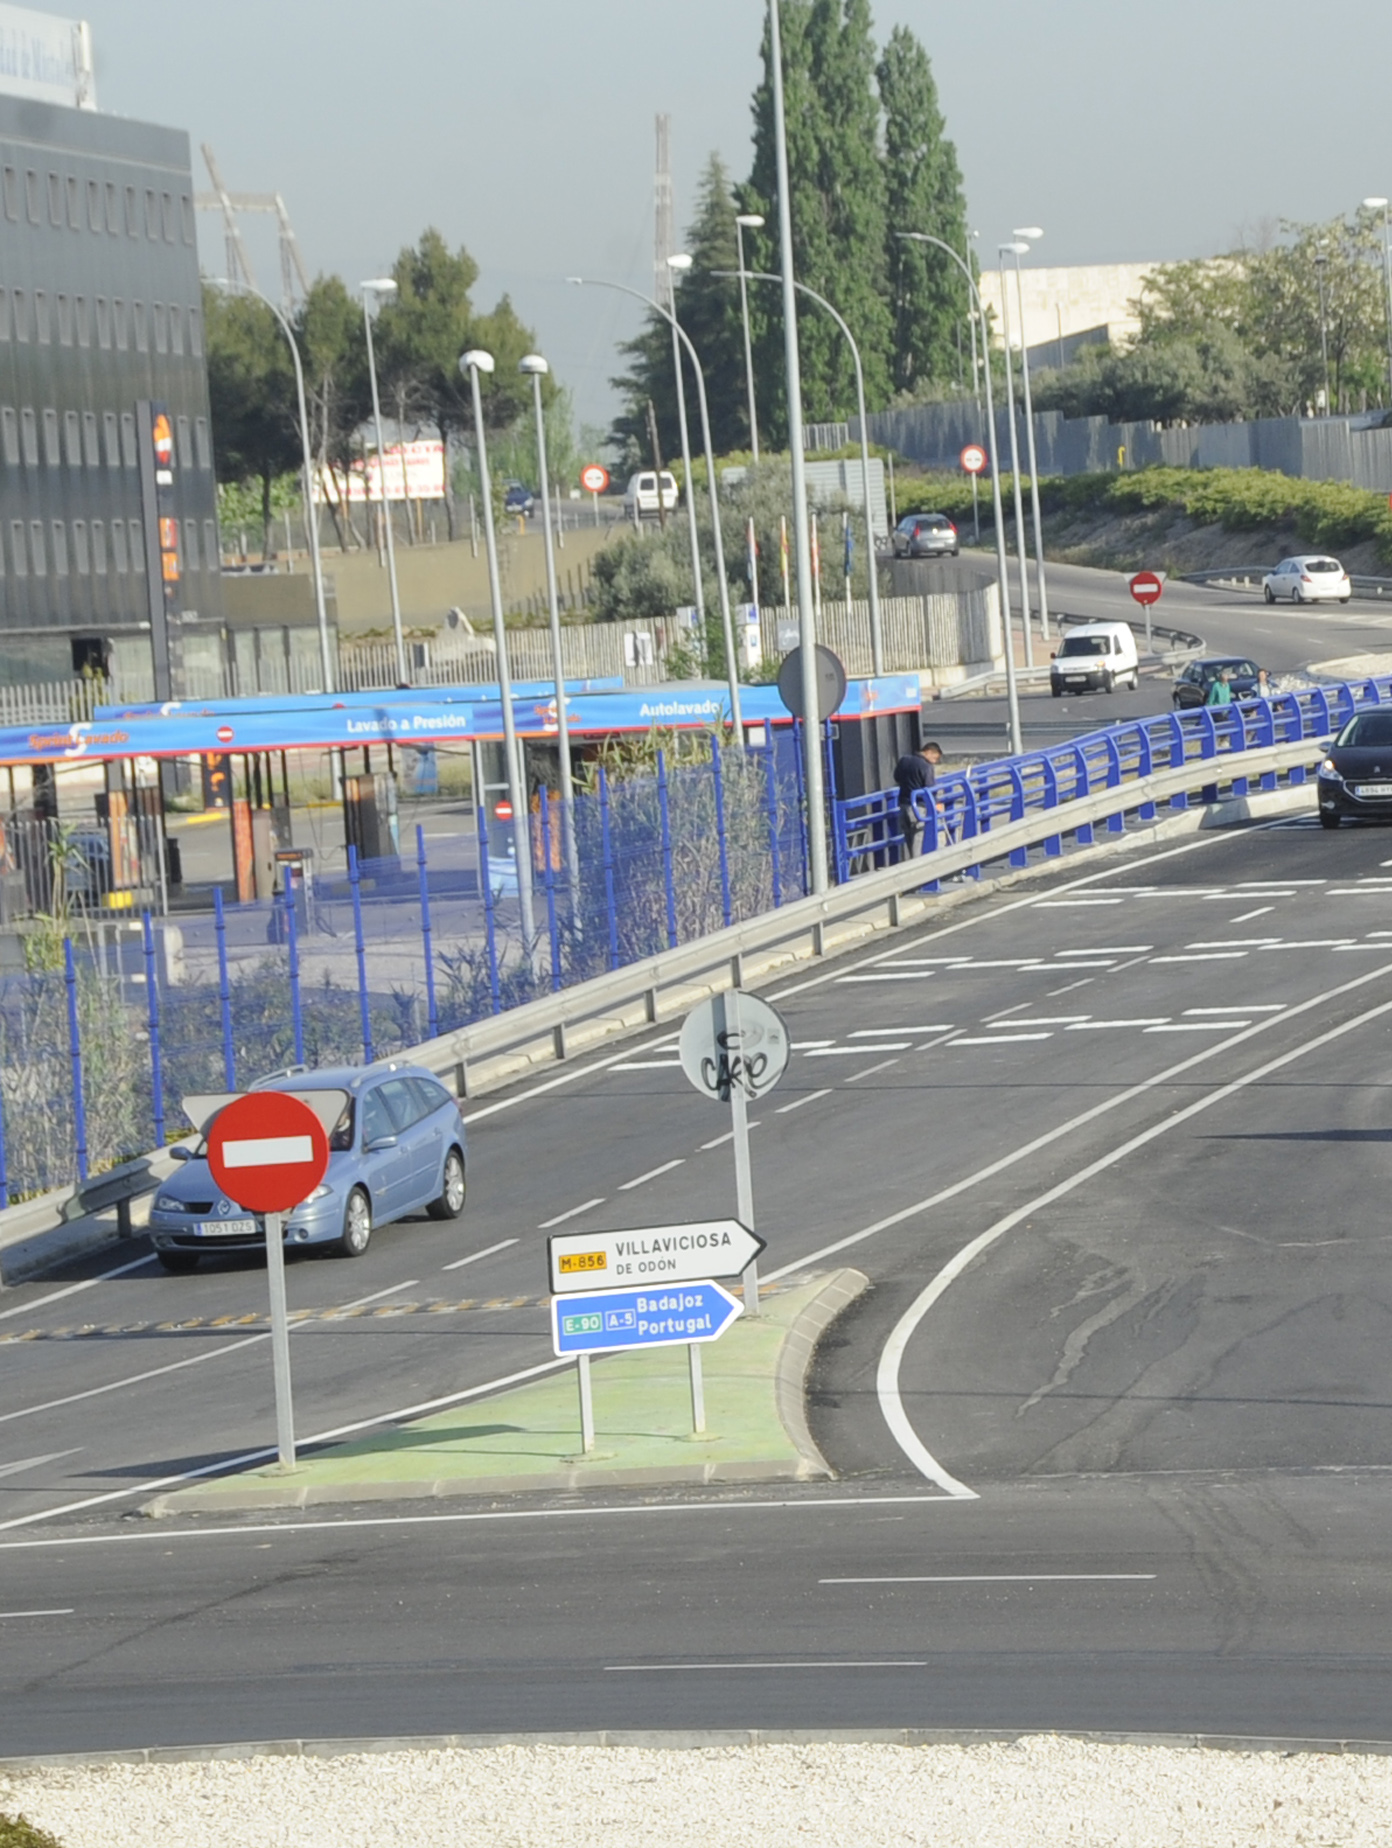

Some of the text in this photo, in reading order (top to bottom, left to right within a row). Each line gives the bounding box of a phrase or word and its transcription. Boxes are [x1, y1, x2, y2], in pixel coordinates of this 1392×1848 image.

[640, 699, 720, 717] Autolavado
[347, 713, 466, 733] Lavado a Presión
[204, 1223, 229, 1234] 1051
[616, 1231, 732, 1257] VILLAVICIOSA
[561, 1254, 605, 1270] M-856
[616, 1257, 677, 1275] DE ODÓN
[636, 1293, 704, 1315] Badajoz
[565, 1312, 634, 1332] E-90 A-5
[637, 1313, 712, 1336] Portugal
